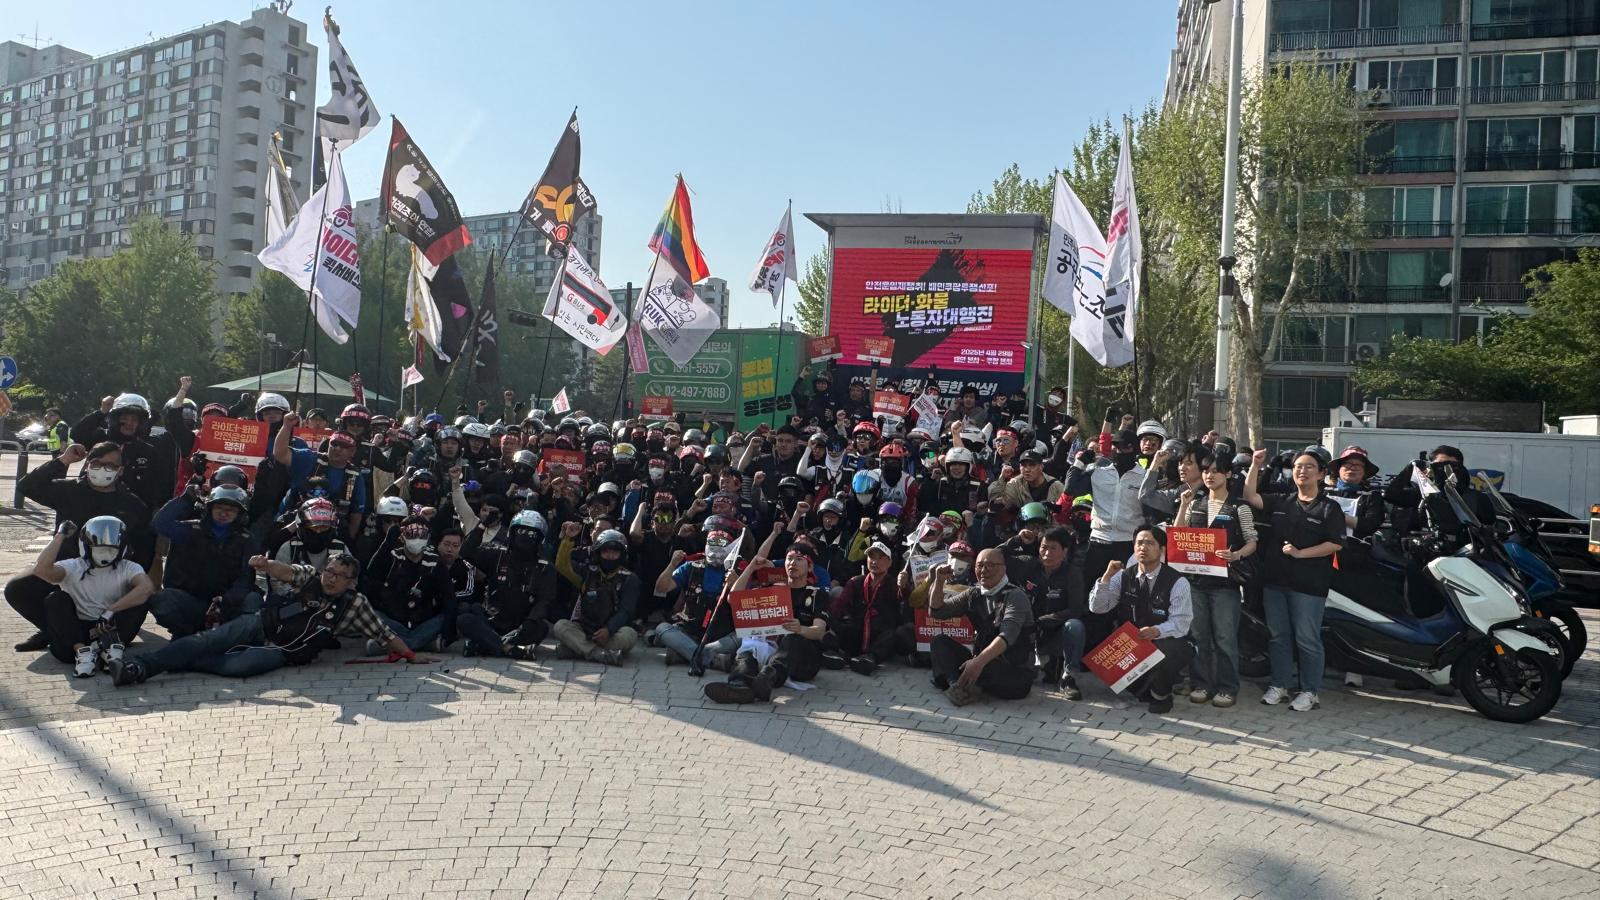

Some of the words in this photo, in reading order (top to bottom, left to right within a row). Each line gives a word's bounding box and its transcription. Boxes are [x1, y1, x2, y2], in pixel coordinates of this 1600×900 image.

[895, 305, 993, 328] 노동자대행진
[664, 385, 726, 399] 02-497-7888
[735, 609, 759, 620] 착취를
[759, 606, 789, 619] 멈춰라!
